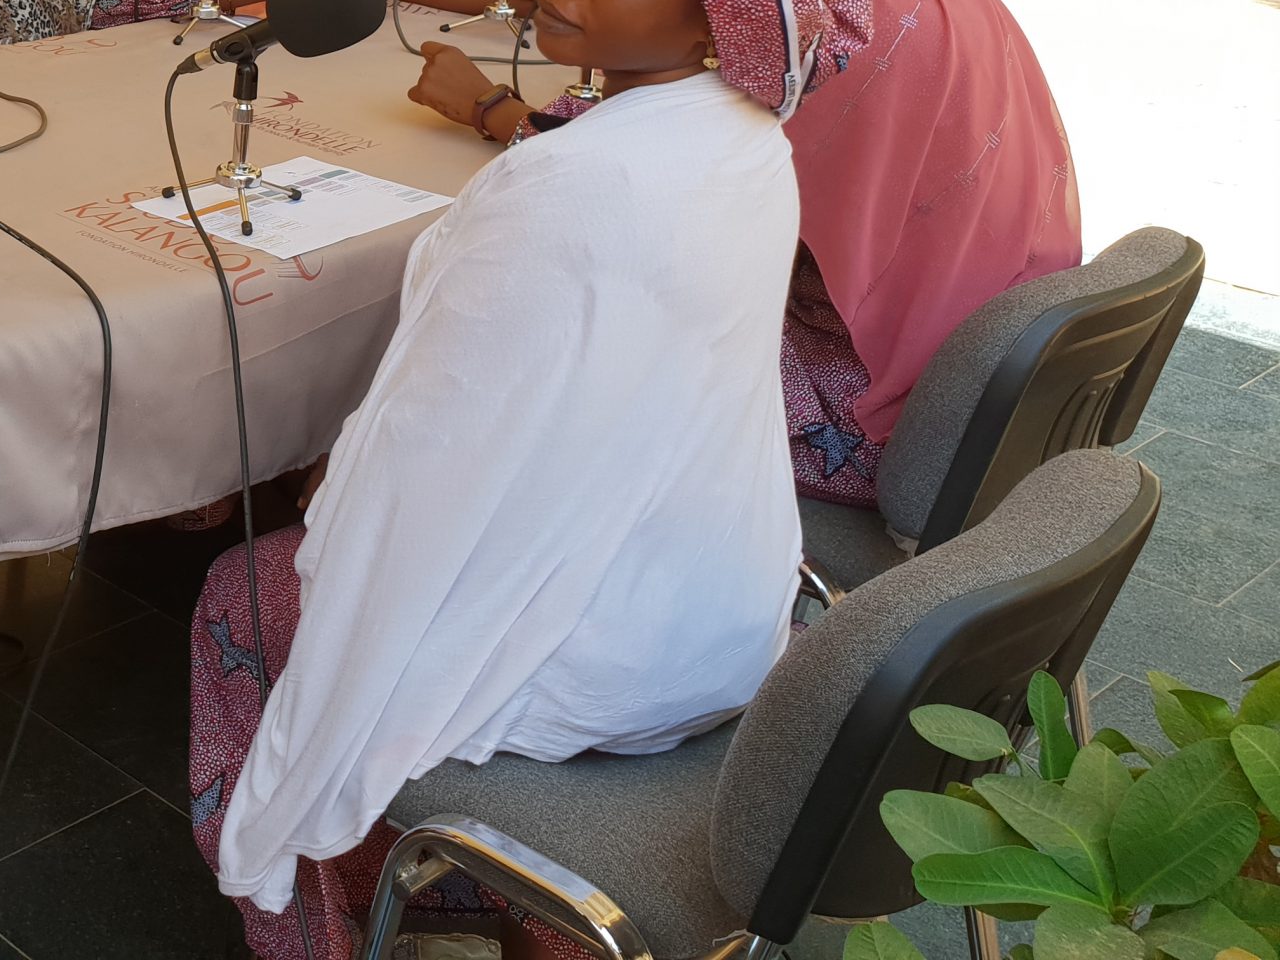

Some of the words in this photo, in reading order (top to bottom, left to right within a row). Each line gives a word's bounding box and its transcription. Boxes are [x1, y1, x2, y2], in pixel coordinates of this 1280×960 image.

[63, 201, 274, 306] KALANGOU
[75, 229, 131, 254] FONDATION
[126, 249, 190, 273] HIRONDELLE
